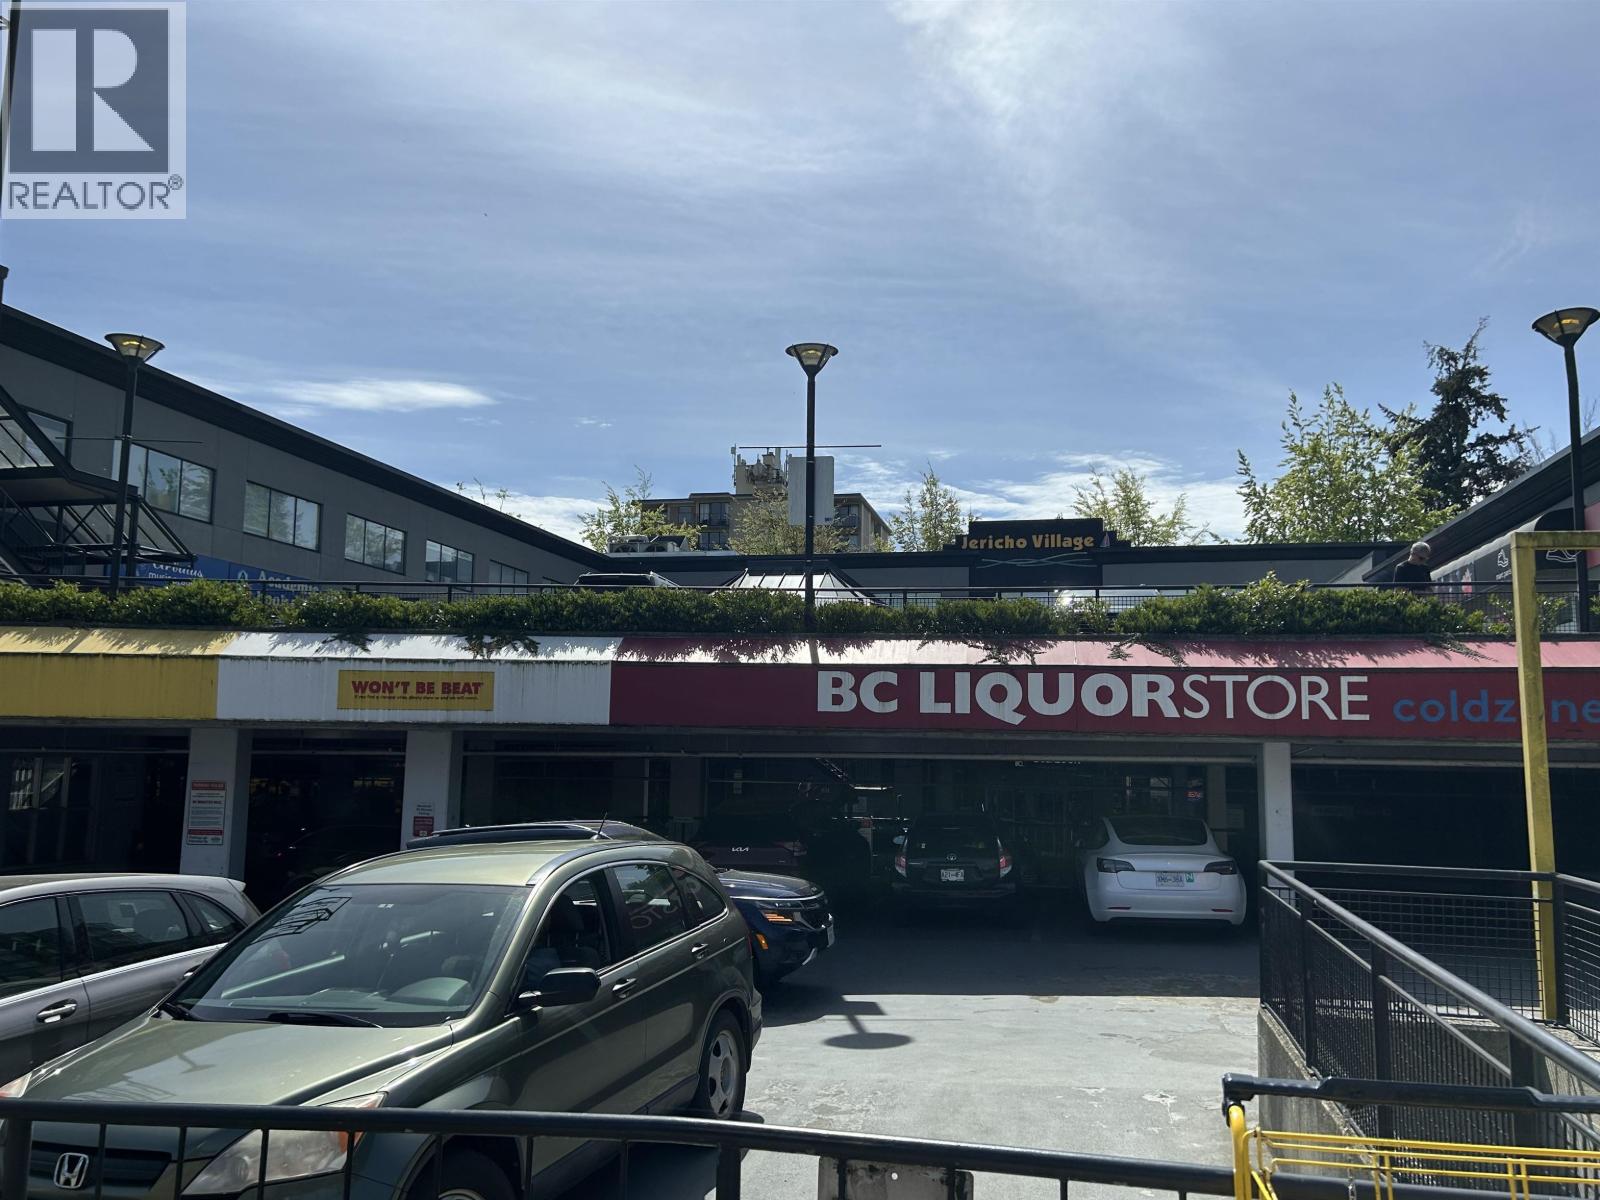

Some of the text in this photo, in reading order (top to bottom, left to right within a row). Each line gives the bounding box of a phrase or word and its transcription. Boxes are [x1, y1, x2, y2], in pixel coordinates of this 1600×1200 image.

[961, 533, 1095, 550] Jericho Village
[352, 680, 483, 695] WON'T BE BEAT
[817, 670, 898, 713] BC
[1392, 689, 1600, 724] coldzne
